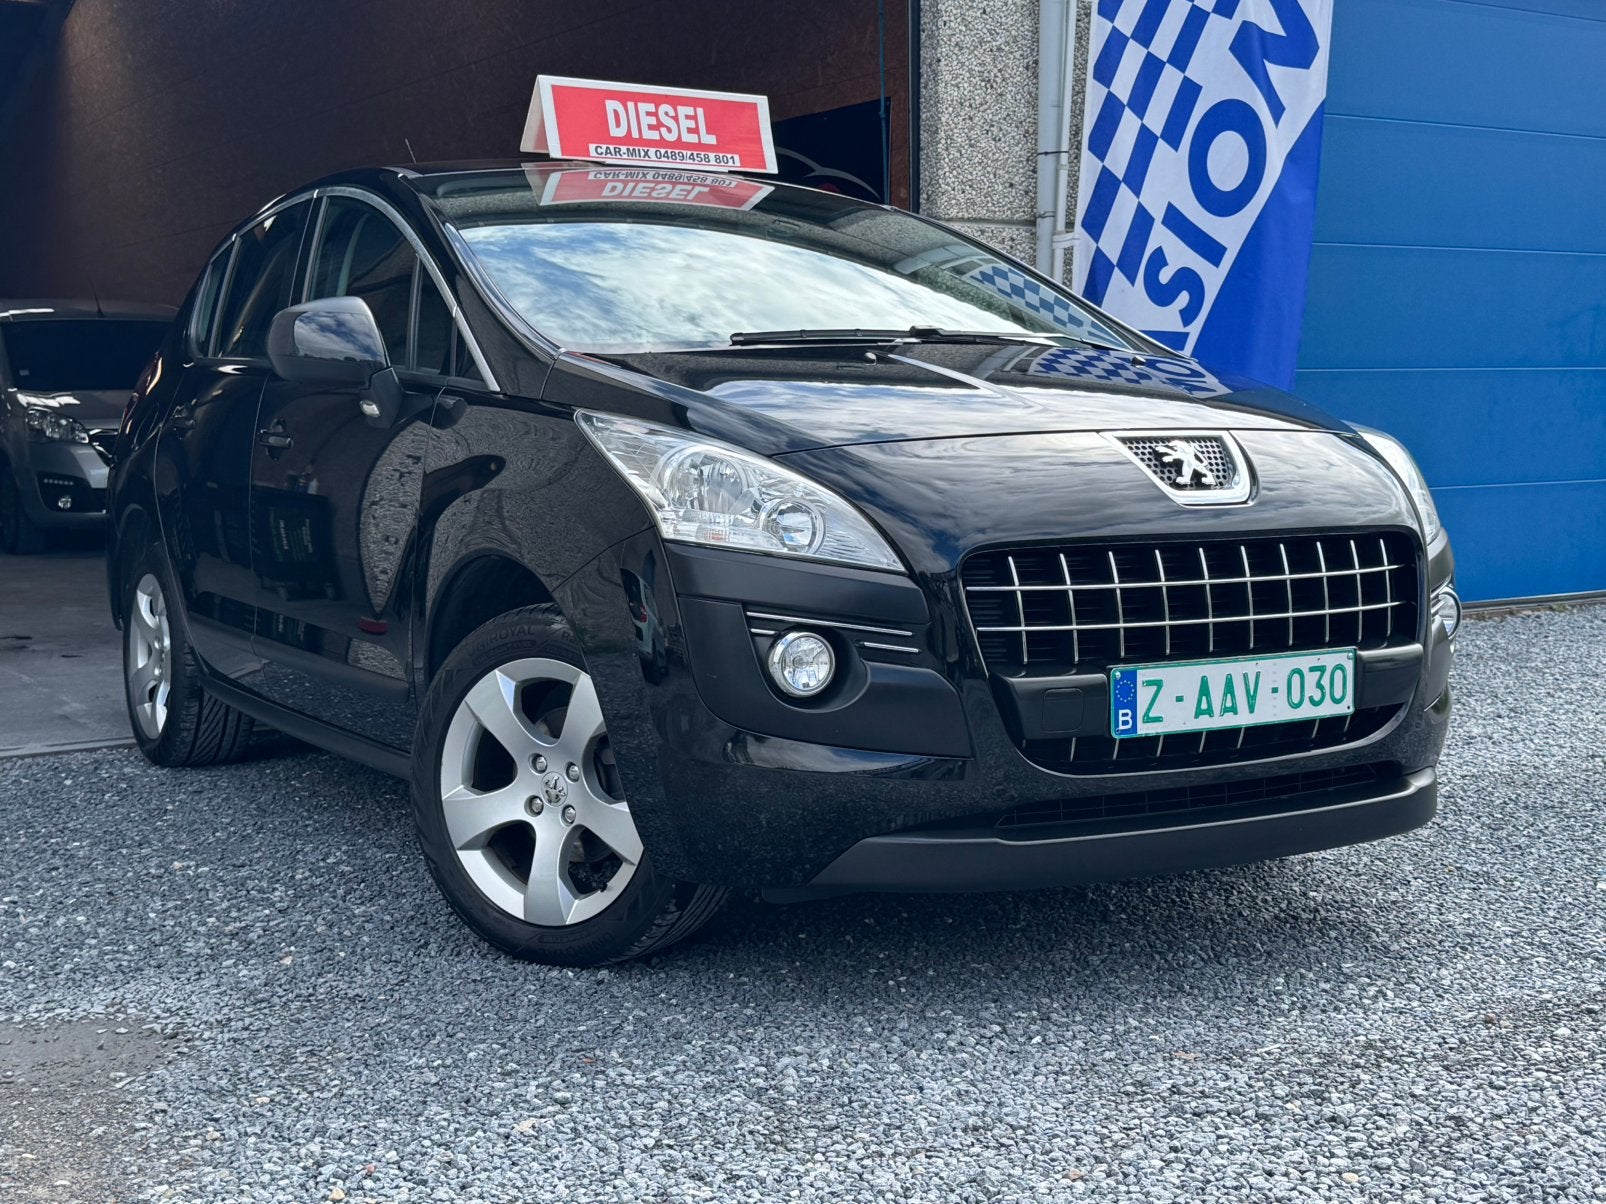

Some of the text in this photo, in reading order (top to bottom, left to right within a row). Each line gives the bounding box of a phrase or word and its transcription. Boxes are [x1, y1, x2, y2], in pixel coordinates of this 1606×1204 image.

[605, 99, 716, 145] DIESEL
[594, 145, 736, 166] CAR-MIX 0489/458 801
[1141, 663, 1348, 724] Z-AAV-030
[1117, 708, 1134, 731] B
